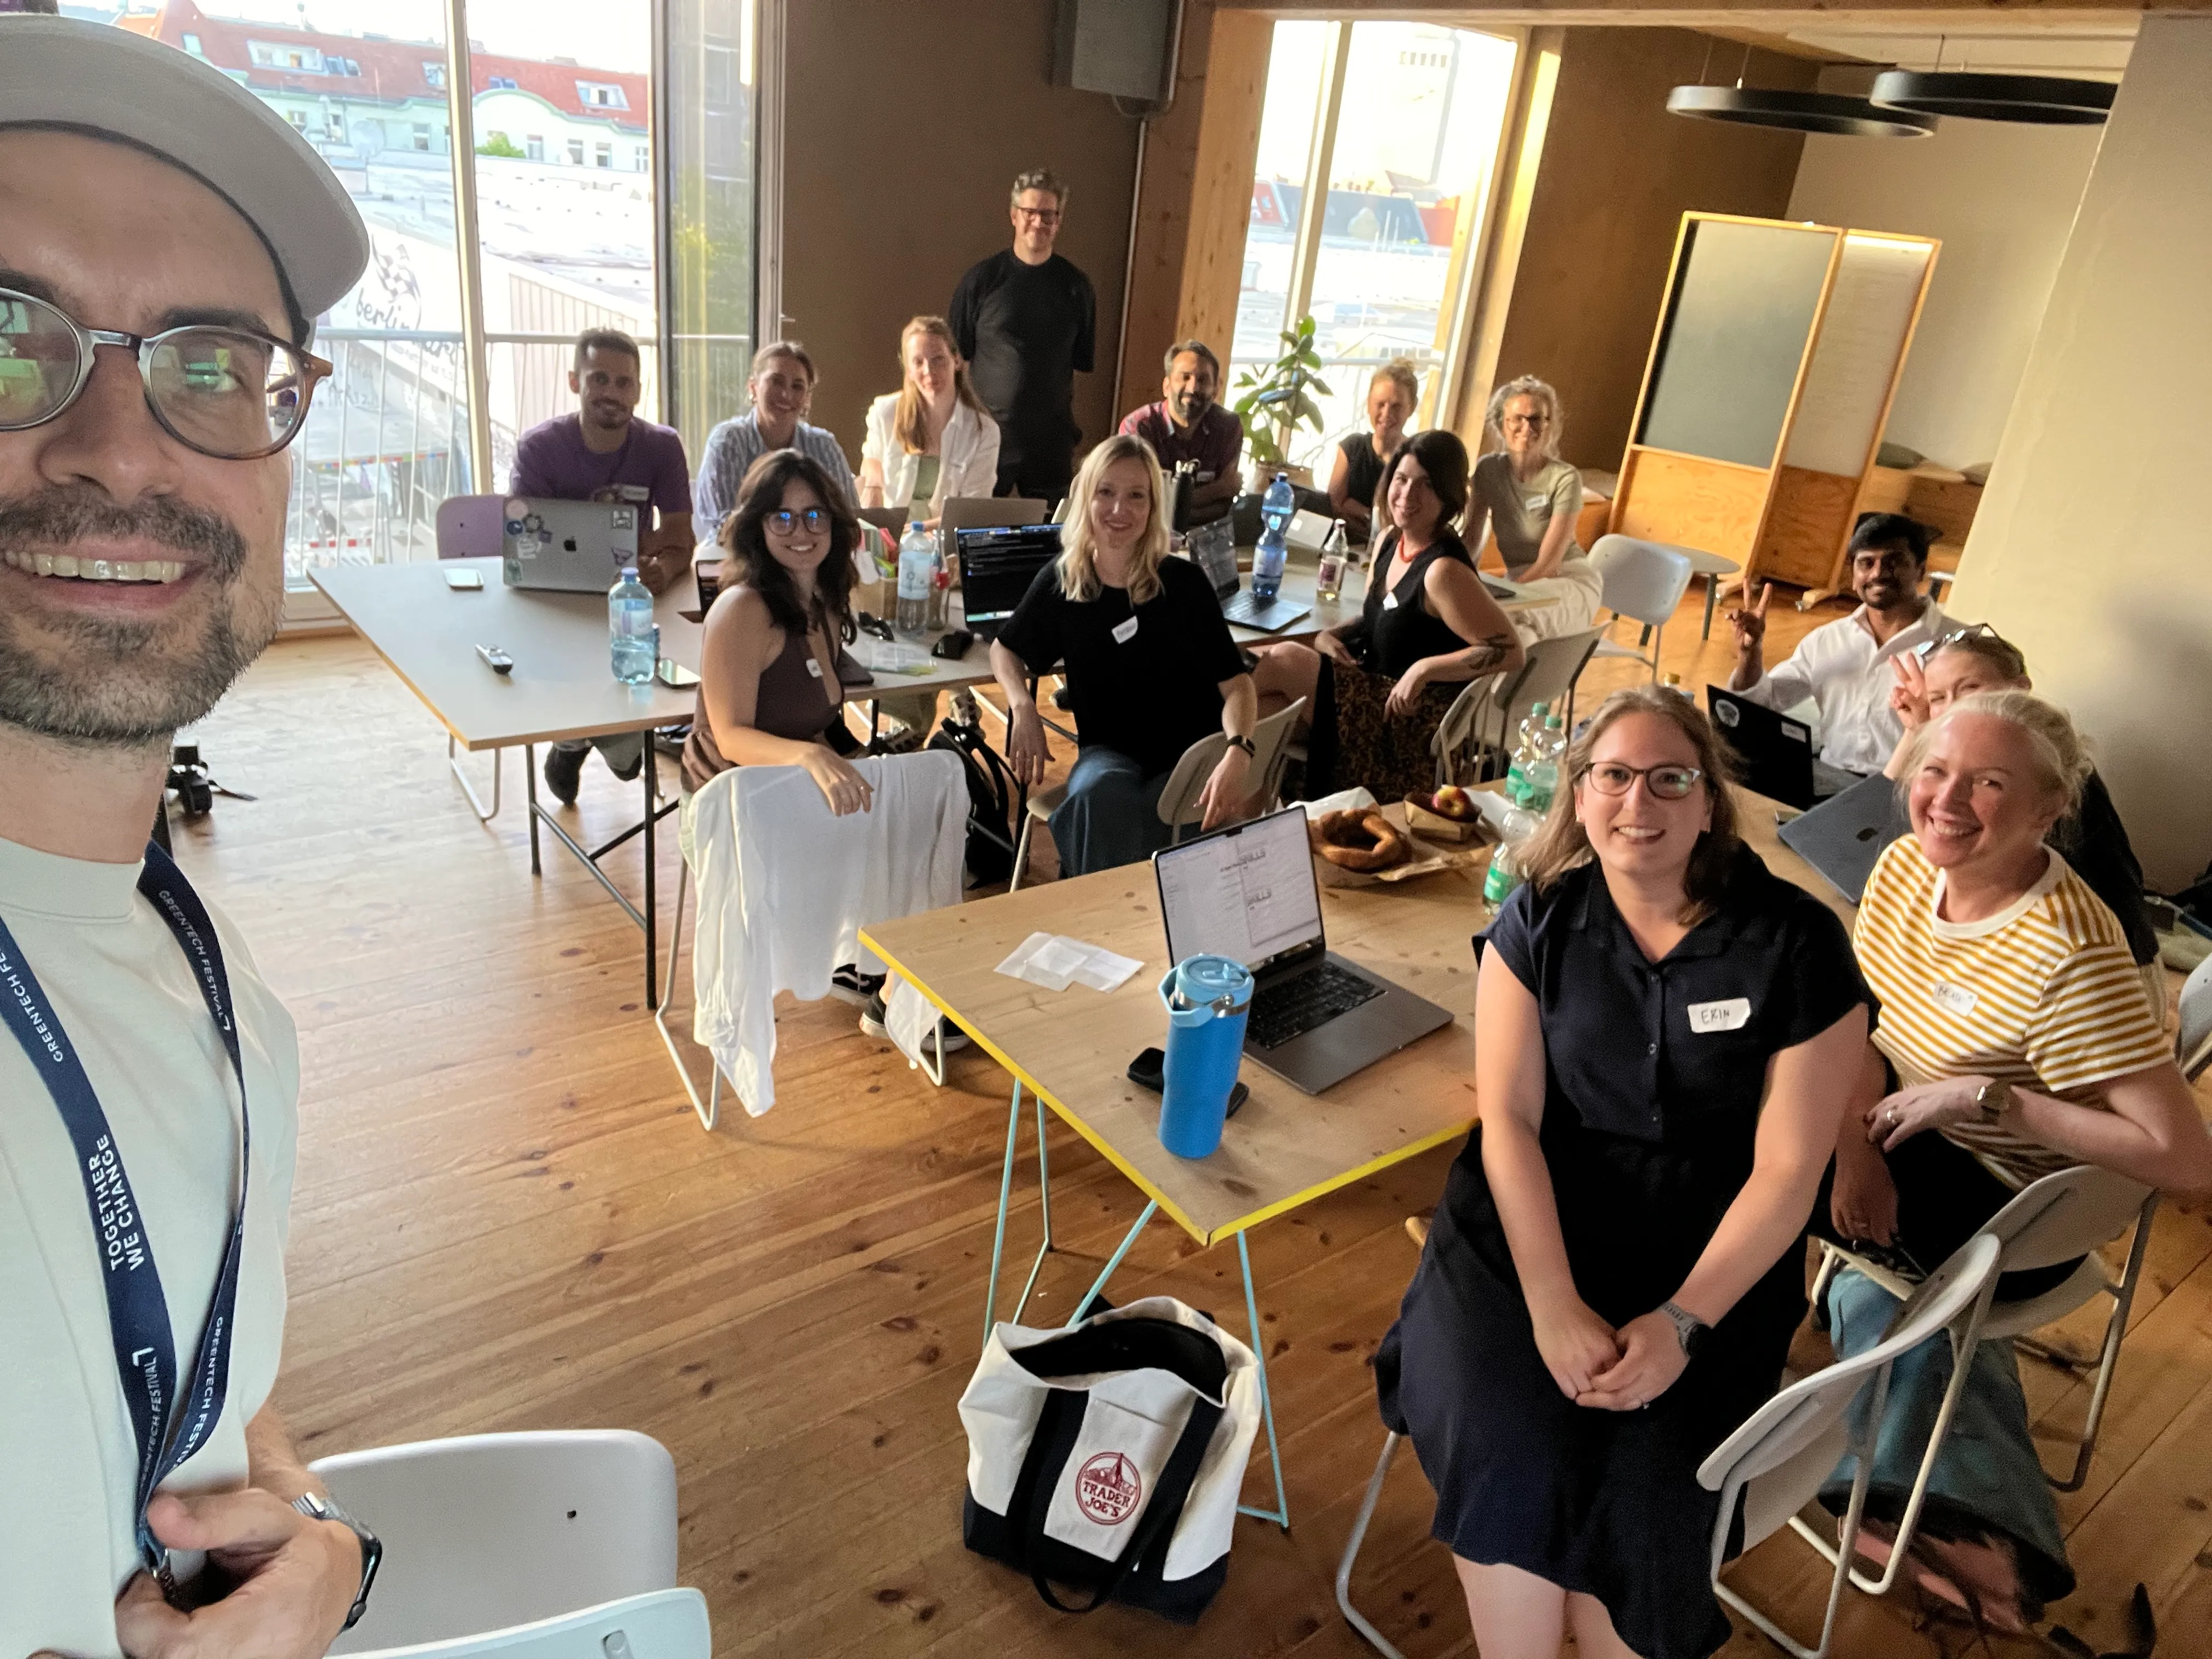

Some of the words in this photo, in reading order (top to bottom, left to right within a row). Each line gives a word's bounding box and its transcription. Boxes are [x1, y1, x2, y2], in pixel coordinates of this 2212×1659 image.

[159, 890, 206, 955] GREENTECH
[201, 959, 223, 1019] FESTIVAL
[7, 974, 63, 1062] GREENTECH
[89, 1154, 125, 1271] TOGETHER
[97, 1134, 133, 1228] CHANGE
[123, 1232, 145, 1271] WE
[201, 1317, 223, 1409] GREENTECH
[1084, 1481, 1131, 1508] TRADER
[1085, 1497, 1121, 1517] JOE'S
